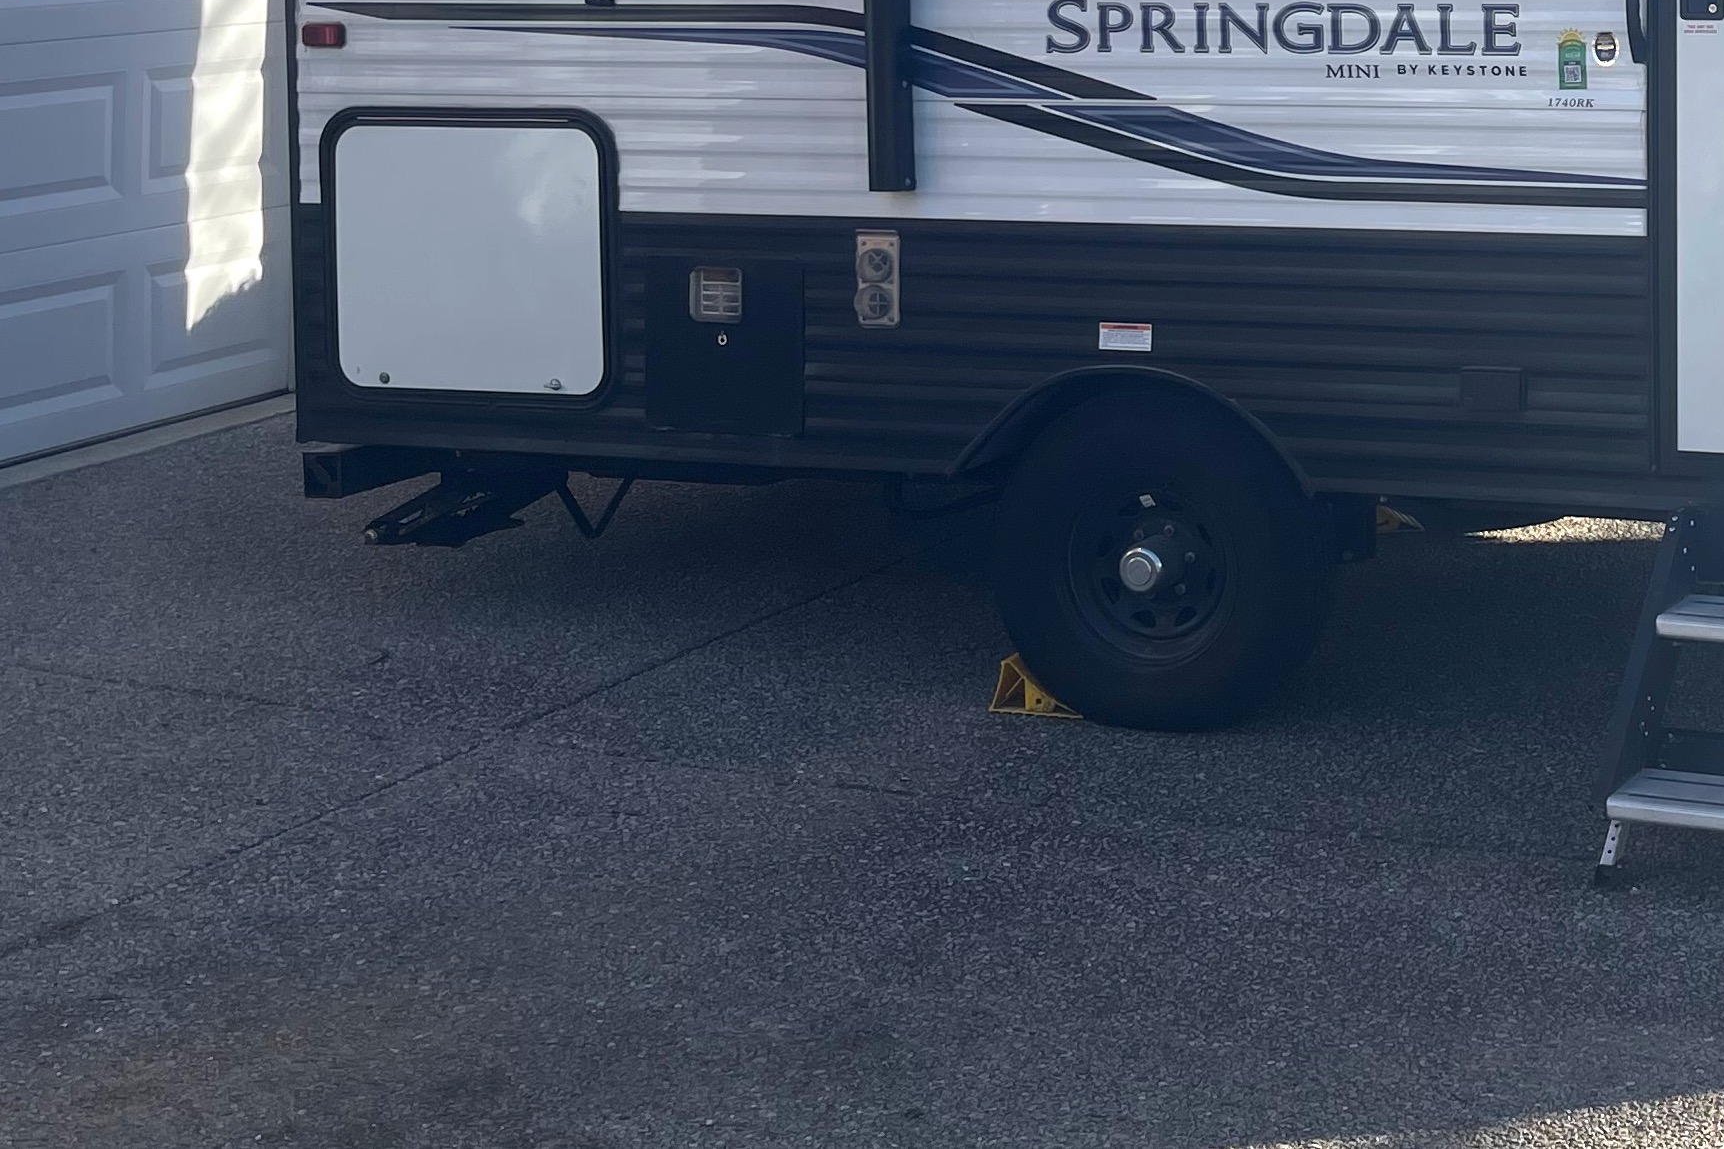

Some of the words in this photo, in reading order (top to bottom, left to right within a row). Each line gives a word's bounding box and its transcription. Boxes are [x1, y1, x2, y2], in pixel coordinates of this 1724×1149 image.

[1325, 64, 1381, 79] MINI
[1397, 64, 1419, 76] BY
[1427, 64, 1528, 77] KEYSTONE
[1548, 97, 1595, 108] 1740RK
